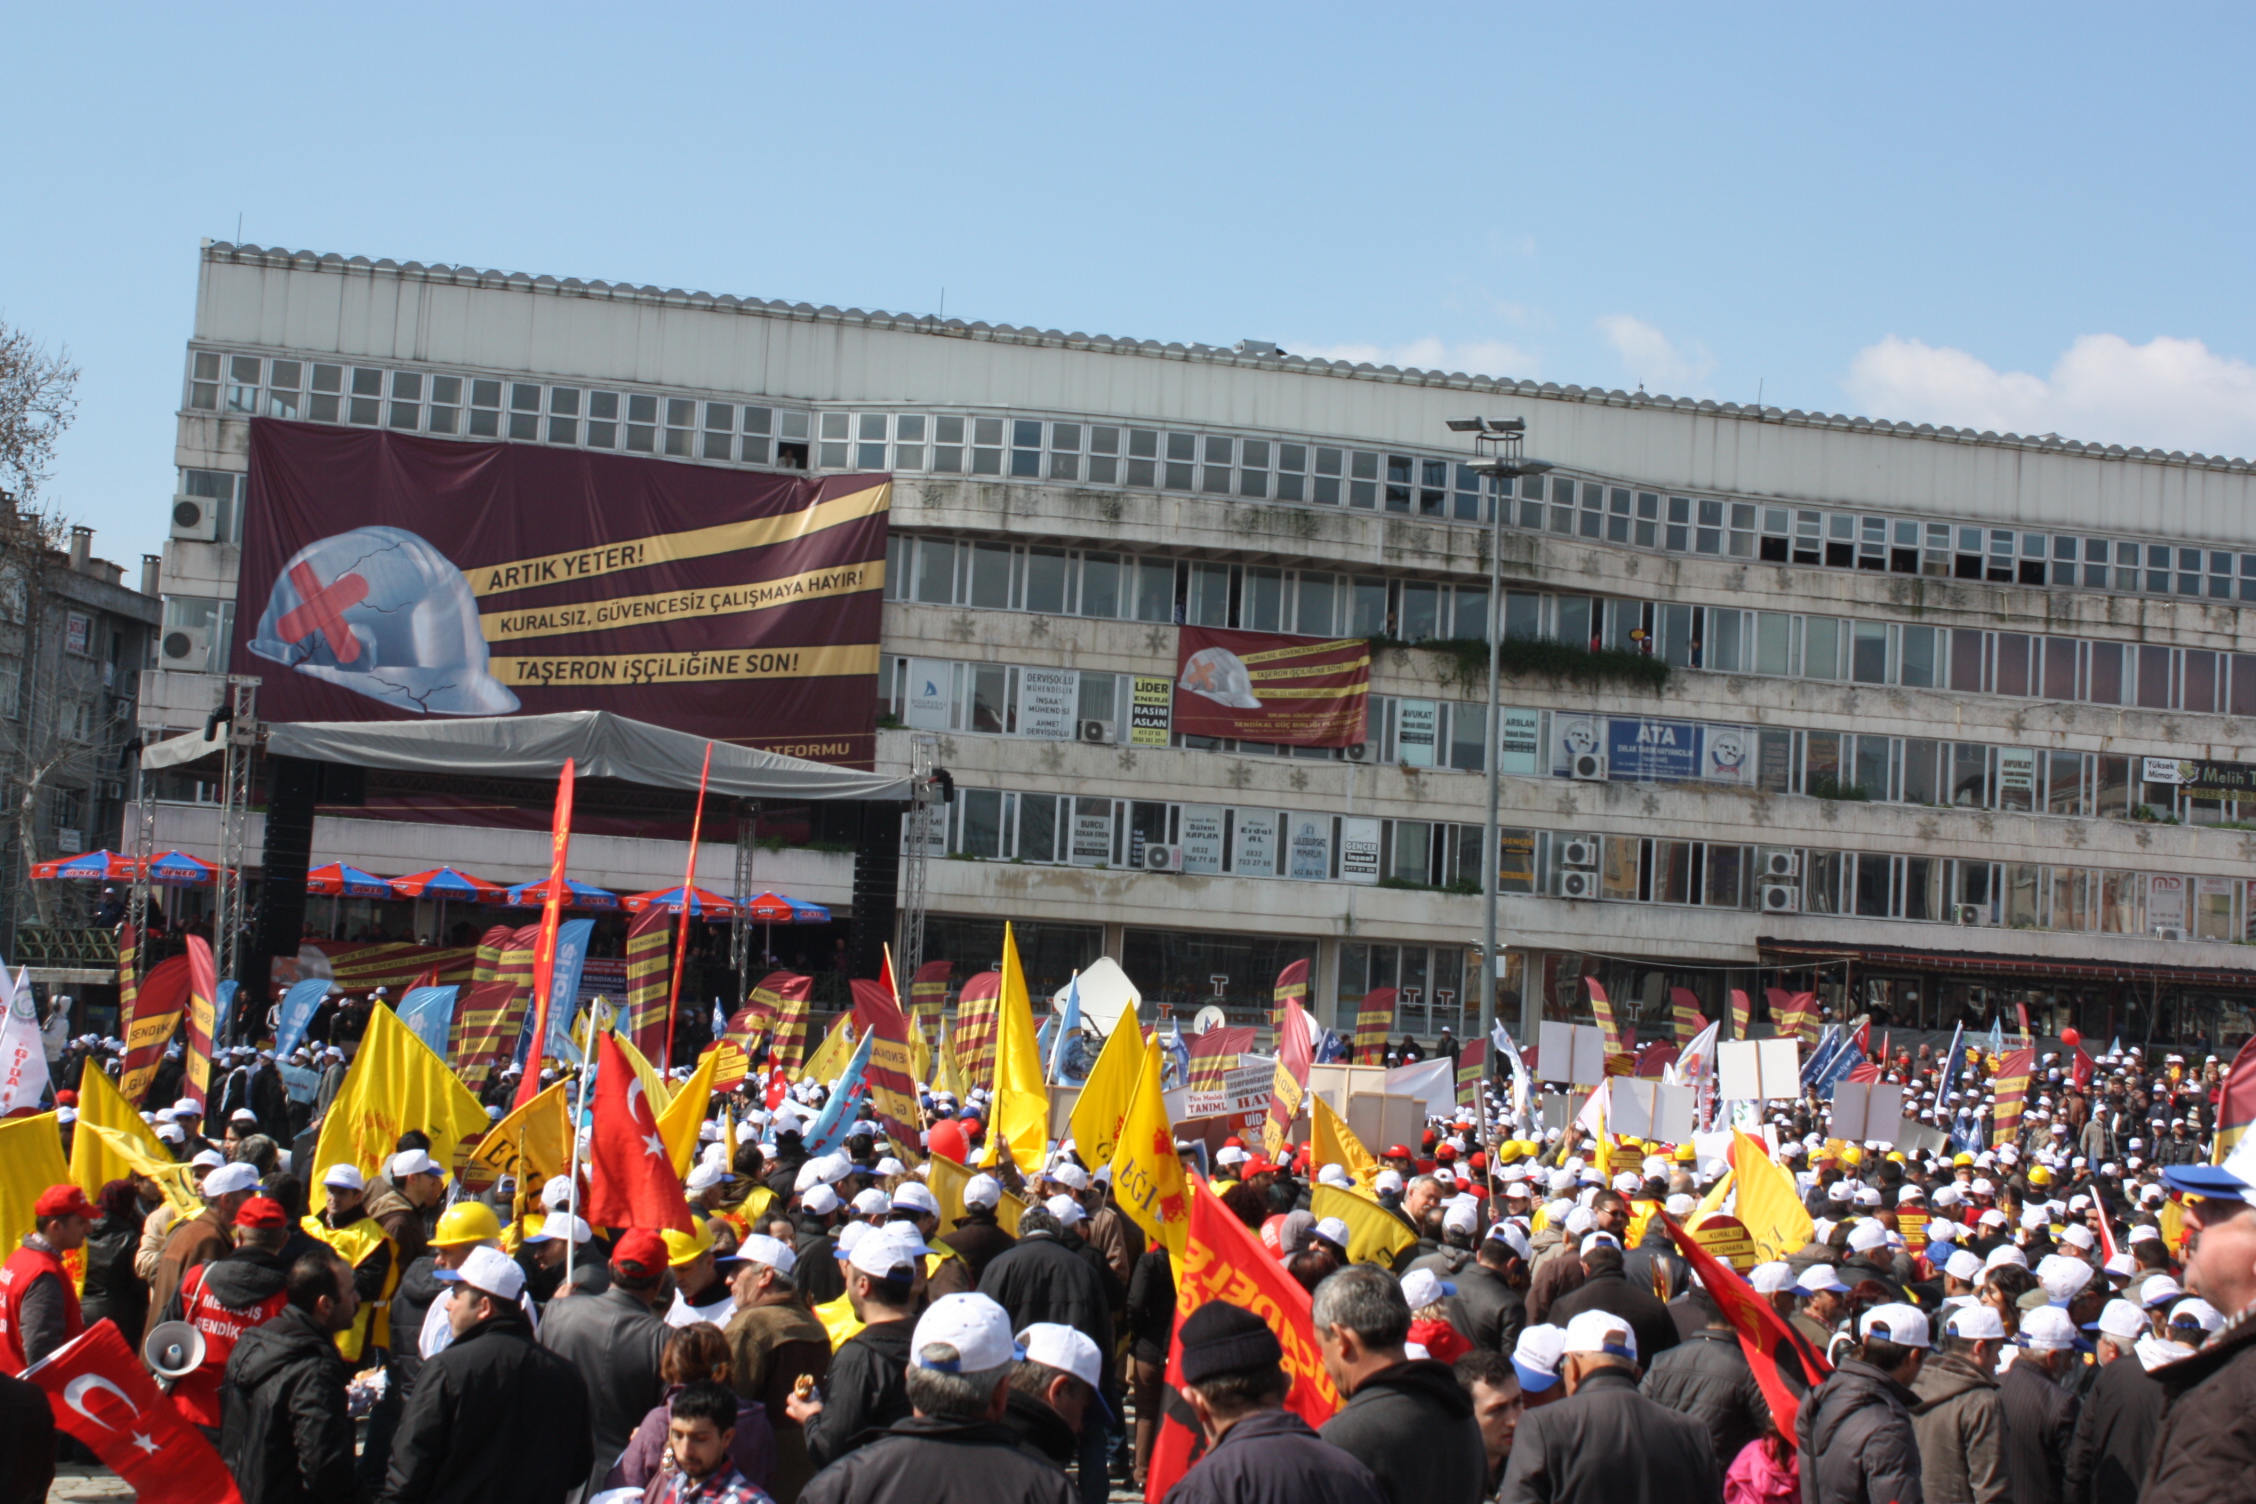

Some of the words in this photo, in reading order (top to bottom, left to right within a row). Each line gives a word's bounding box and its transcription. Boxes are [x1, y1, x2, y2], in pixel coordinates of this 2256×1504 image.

[488, 559, 558, 591] ARTIK
[562, 544, 644, 576] YETER!
[500, 610, 592, 633] KURALSIZ,
[596, 592, 705, 623] GÜVENCESİZ
[710, 581, 804, 613] ÇALIŞMAYA
[808, 570, 863, 592] HAYIR!
[516, 661, 617, 687] TAŞERON
[744, 653, 799, 673] SON!
[1134, 679, 1169, 694] LİDER
[1134, 695, 1168, 703] ENERJİ
[1028, 705, 1070, 715] MÜHENDSİ
[1134, 706, 1167, 717] RASİM
[1402, 709, 1433, 719] AVUKAT
[1035, 720, 1061, 728] AHMET
[1133, 718, 1167, 728] ASLAN
[1234, 720, 1274, 729] SENDİKAL
[1274, 720, 1291, 730] GÜÇ
[1505, 718, 1536, 728] ARSLAN
[1635, 724, 1677, 746] ATA
[752, 743, 851, 757] ATFORMU
[2147, 760, 2175, 770] Yüksek
[2147, 770, 2174, 779] Mimar
[2202, 766, 2244, 785] Melih
[1080, 820, 1104, 829] BURCU
[1189, 823, 1216, 831] Bülent
[1240, 826, 1272, 835] Erdal
[1185, 832, 1219, 840] KAPLAN
[1345, 840, 1378, 854] GENÇER
[159, 866, 197, 878] ÜLKER
[352, 885, 384, 896] ÜLKER
[431, 887, 467, 899] ÜLKER
[503, 954, 535, 962] SENDİKA
[1210, 974, 1229, 997] T
[1403, 987, 1421, 1008] T
[1437, 989, 1455, 1010] T
[1626, 1000, 1643, 1021] T
[130, 1021, 175, 1042] SENDİK
[1246, 1065, 1275, 1077] çalışmay
[1227, 1074, 1275, 1090] taşeronlaştır
[1228, 1083, 1274, 1099] sendikasızlaş
[1236, 1092, 1271, 1110] HAY
[1188, 1102, 1228, 1114] TANIML
[1244, 1111, 1266, 1127] UİD-
[1708, 1227, 1742, 1239] KURALSIZ
[195, 1317, 243, 1340] SENDİK
